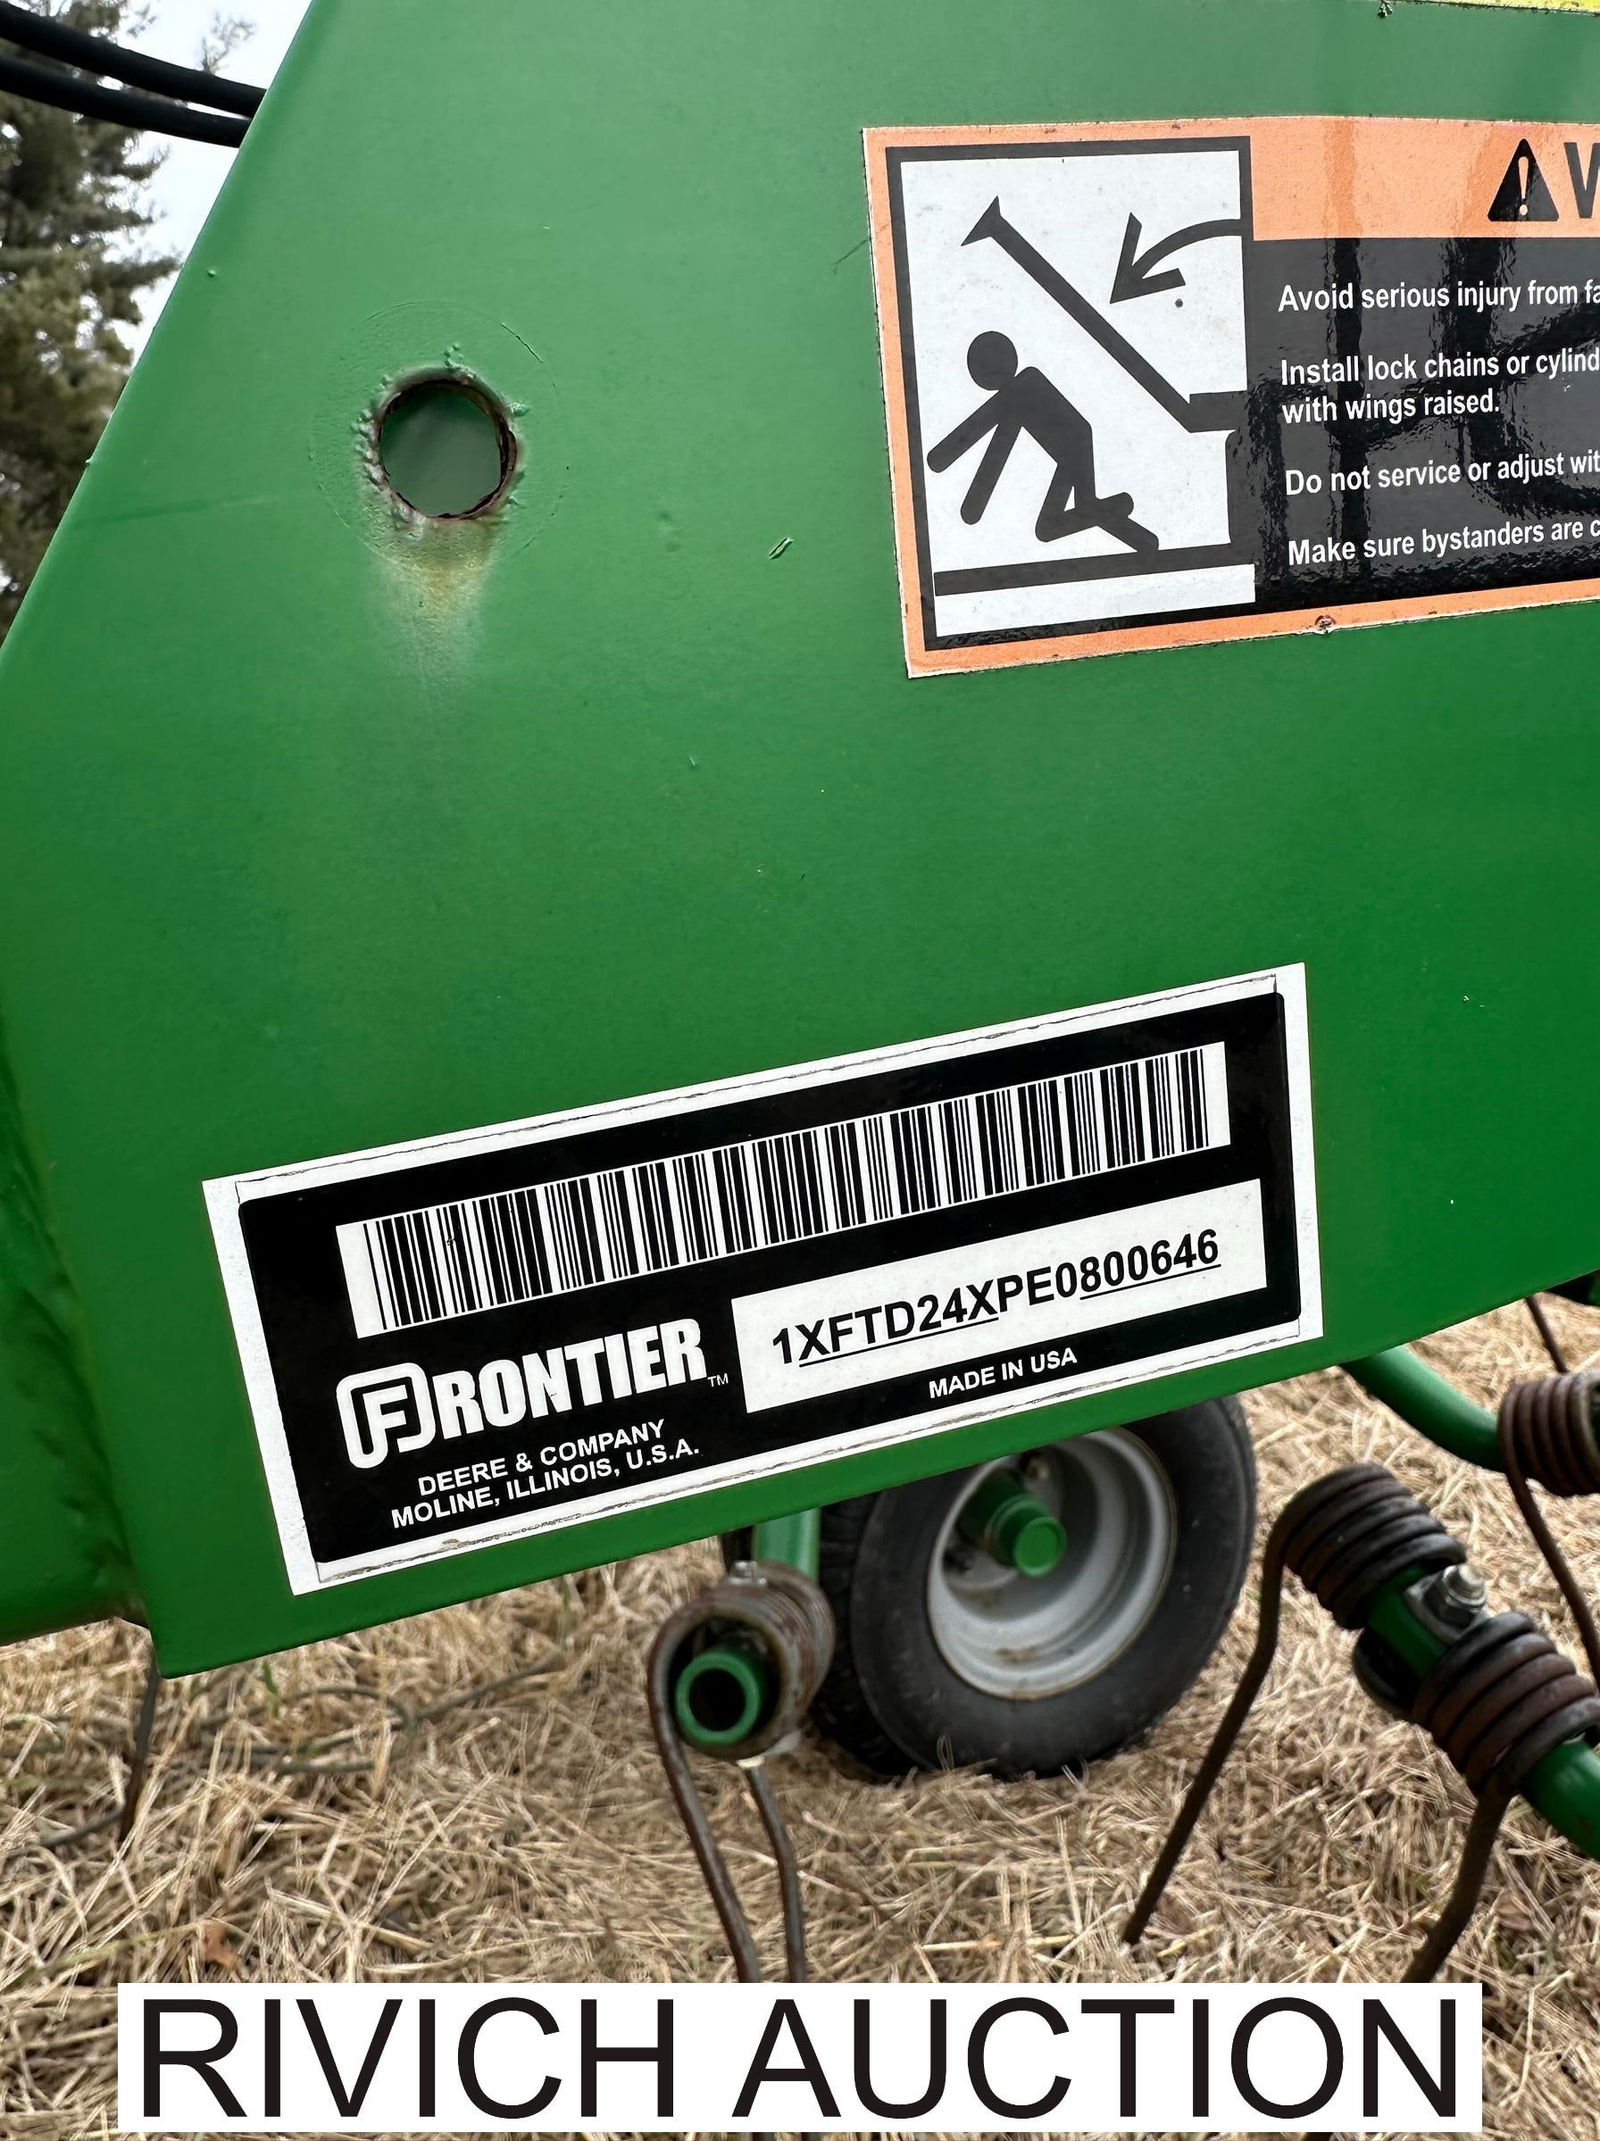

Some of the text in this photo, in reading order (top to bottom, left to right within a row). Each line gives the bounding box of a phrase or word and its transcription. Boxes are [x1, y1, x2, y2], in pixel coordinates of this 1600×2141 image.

[1278, 283, 1353, 312] Avoid
[1362, 284, 1449, 308] serious
[1458, 281, 1521, 312] injury
[1528, 280, 1577, 304] from
[1282, 356, 1358, 385] Install
[1368, 354, 1417, 380] lock
[1425, 352, 1499, 378] chains
[1507, 356, 1529, 374] or
[1282, 388, 1499, 424] with wings raised.
[1286, 470, 1321, 495] Do
[1332, 467, 1371, 491] not
[1378, 460, 1460, 487] service
[1468, 463, 1491, 481] or
[1498, 453, 1564, 484] adjust
[1289, 537, 1355, 565] Make
[1364, 536, 1414, 557] sure
[1423, 522, 1544, 557] bystanders
[1551, 522, 1583, 540] are
[772, 1229, 1220, 1367] 1XFTD24XPE0800646
[336, 1318, 707, 1469] FRONTIER
[928, 1348, 1077, 1398] MADE IN USA
[418, 1418, 666, 1496] DEERE & COMPANY
[391, 1437, 700, 1529] MOLINE, ILLINOIS, U.S.A.
